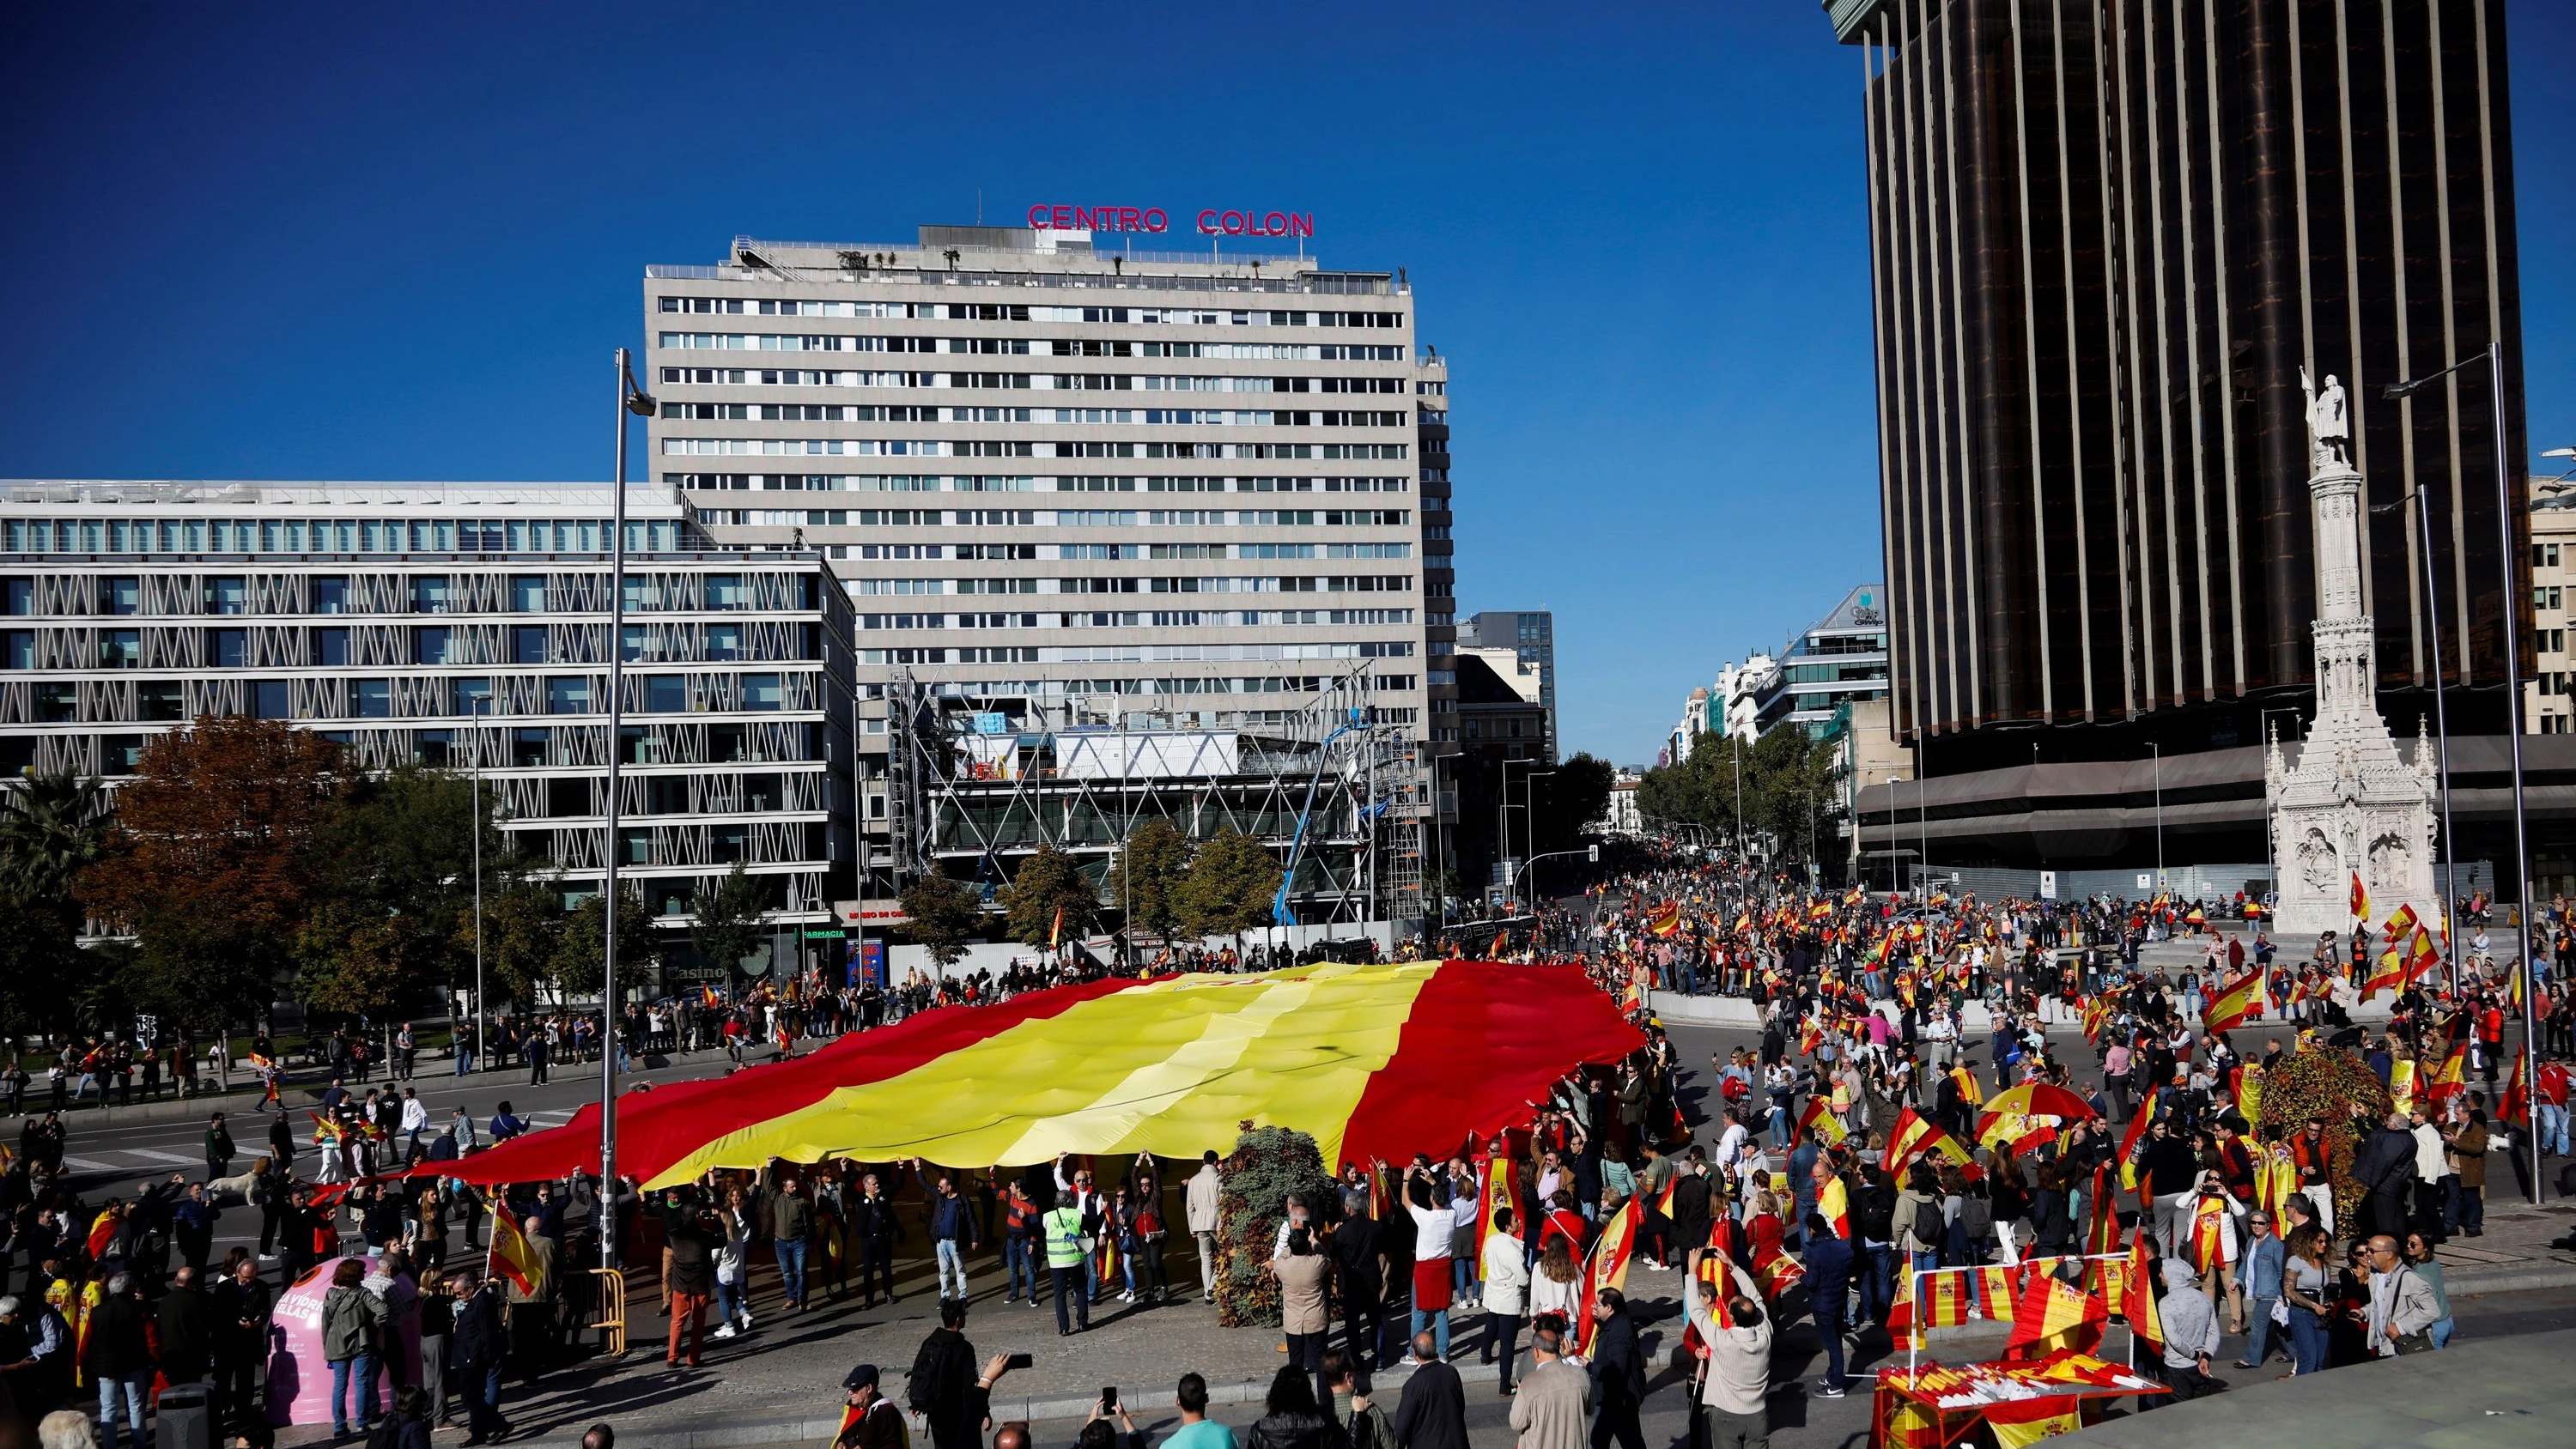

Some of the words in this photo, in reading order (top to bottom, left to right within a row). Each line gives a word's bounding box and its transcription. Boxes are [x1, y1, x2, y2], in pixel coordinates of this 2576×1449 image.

[1029, 204, 1167, 232] CENTRO
[1198, 209, 1314, 237] COLON
[804, 930, 846, 939] FARMACIA
[666, 965, 726, 979] Casino
[1054, 1216, 1074, 1228] VOX
